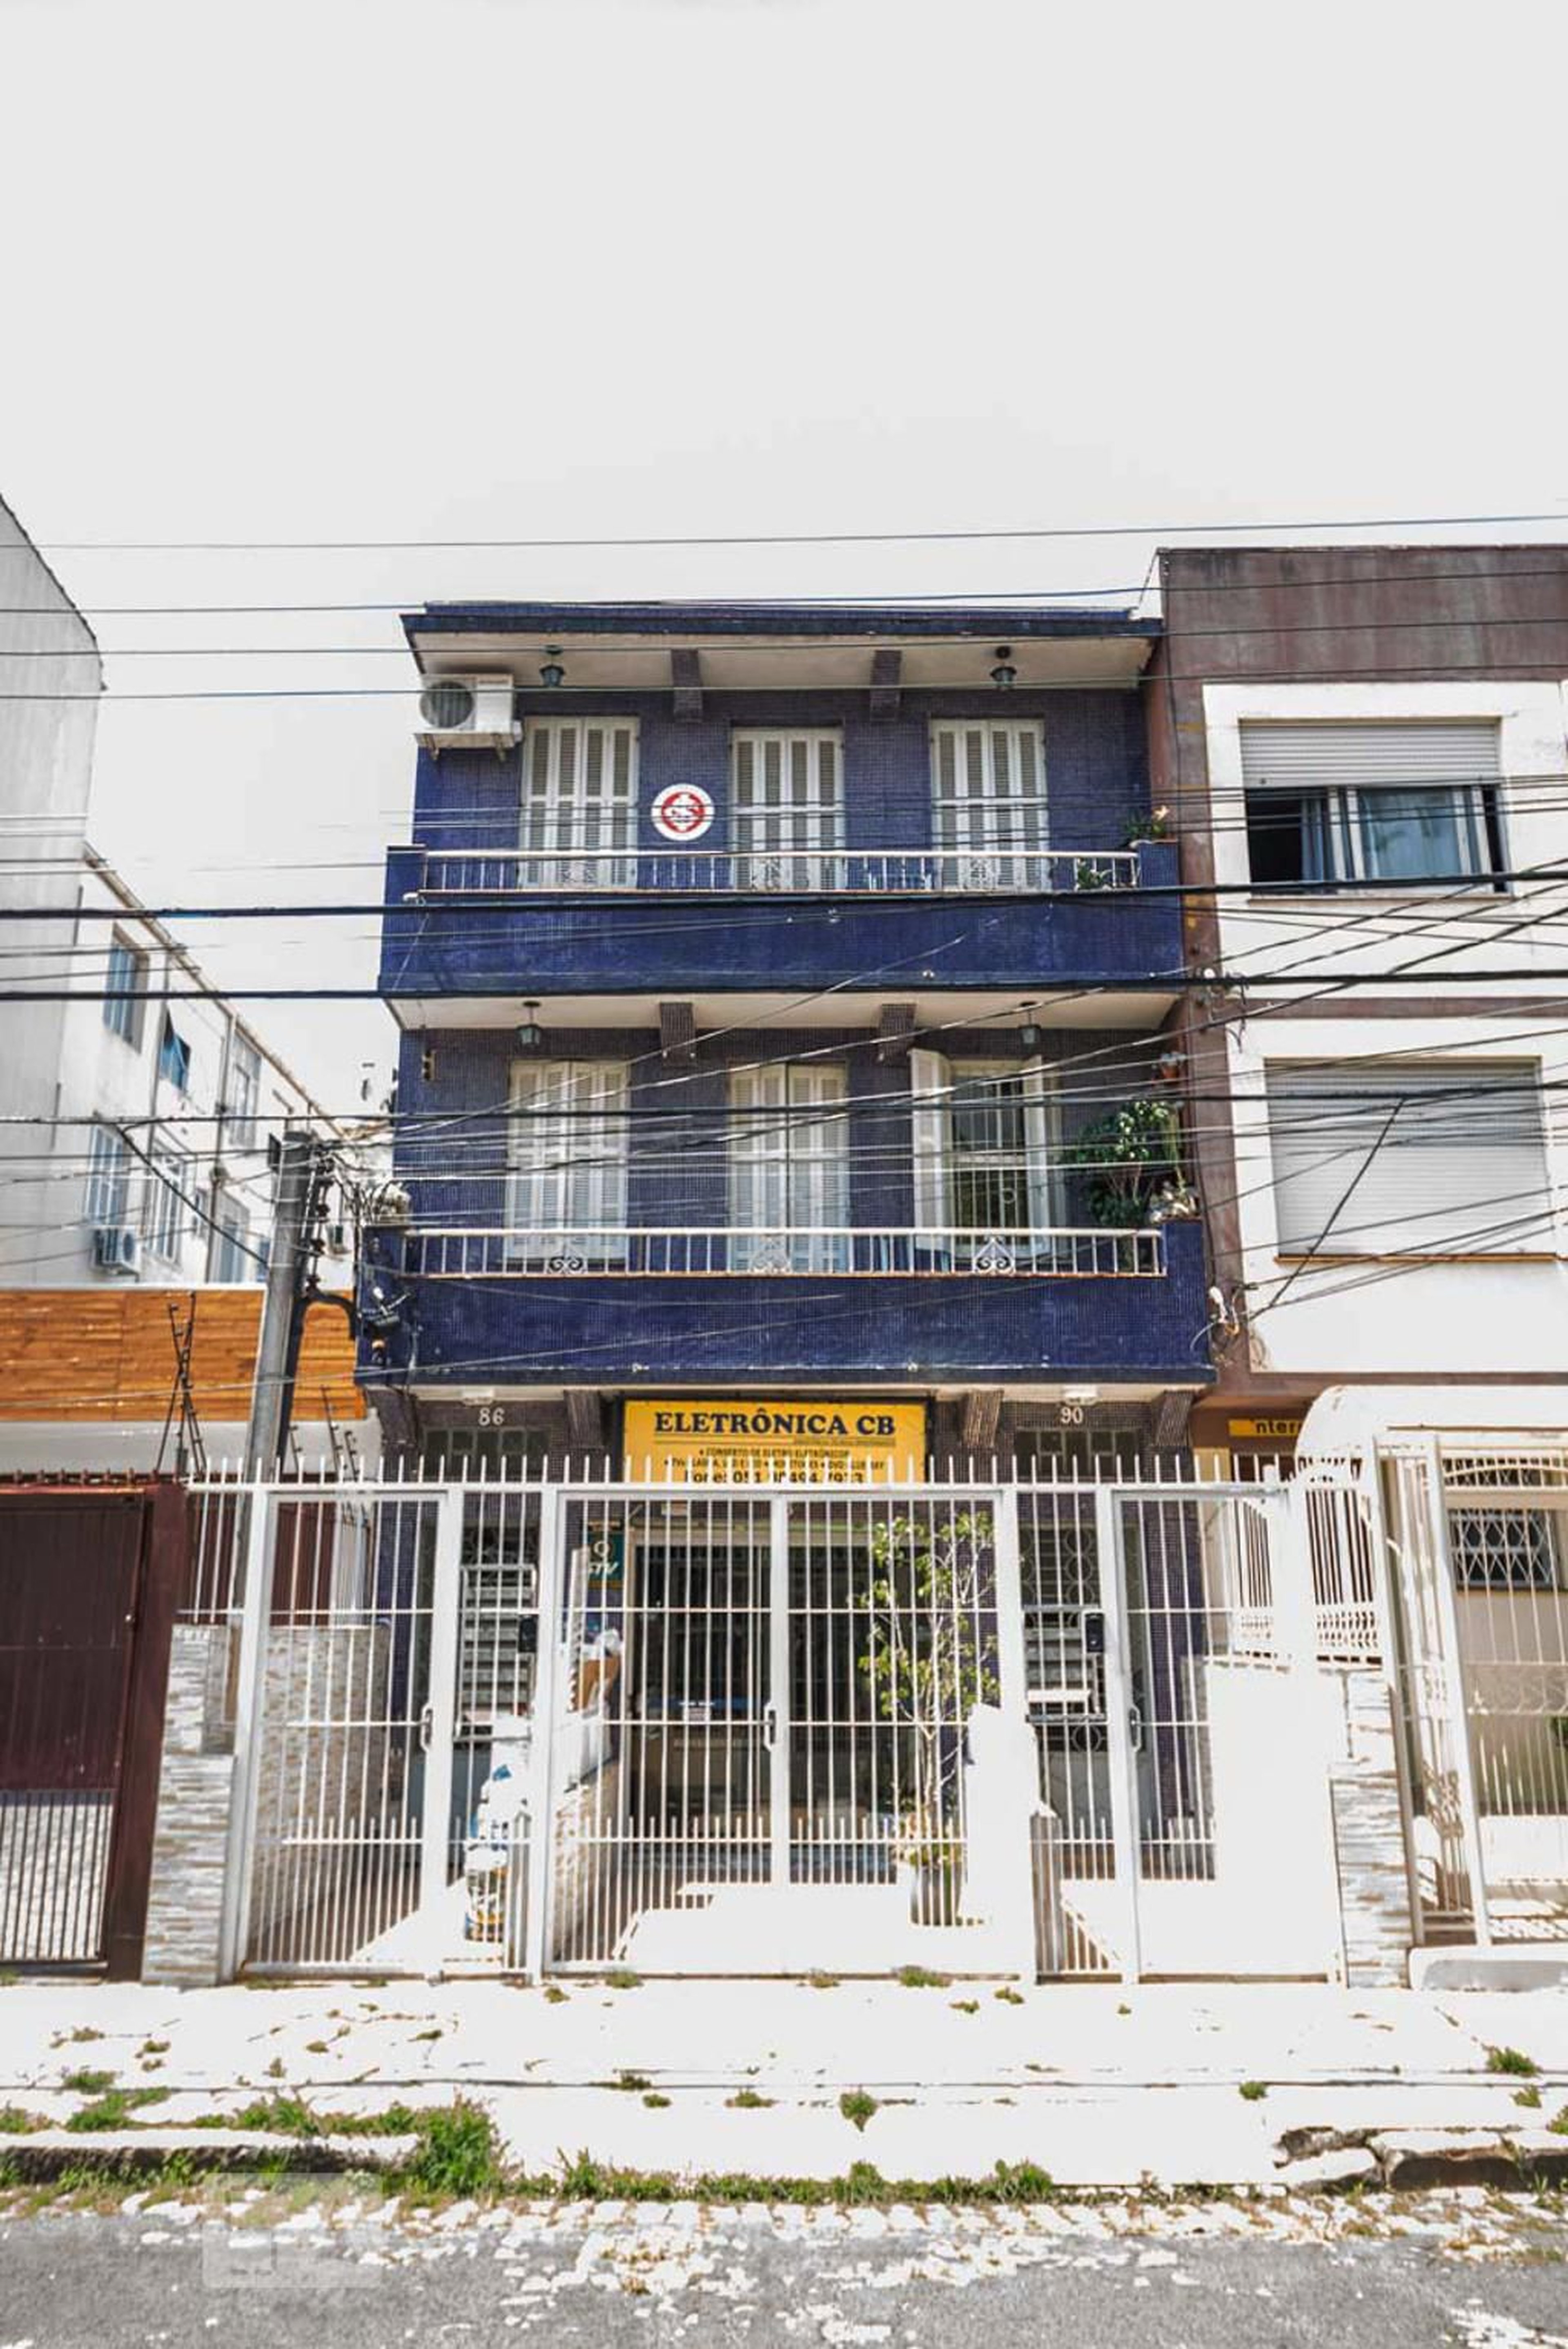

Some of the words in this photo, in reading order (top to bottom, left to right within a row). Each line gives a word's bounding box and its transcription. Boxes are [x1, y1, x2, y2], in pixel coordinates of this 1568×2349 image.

[479, 1407, 505, 1426] 86
[655, 1407, 847, 1434] ELETRÔNICA
[856, 1415, 895, 1434] CB
[1061, 1407, 1083, 1424] 90
